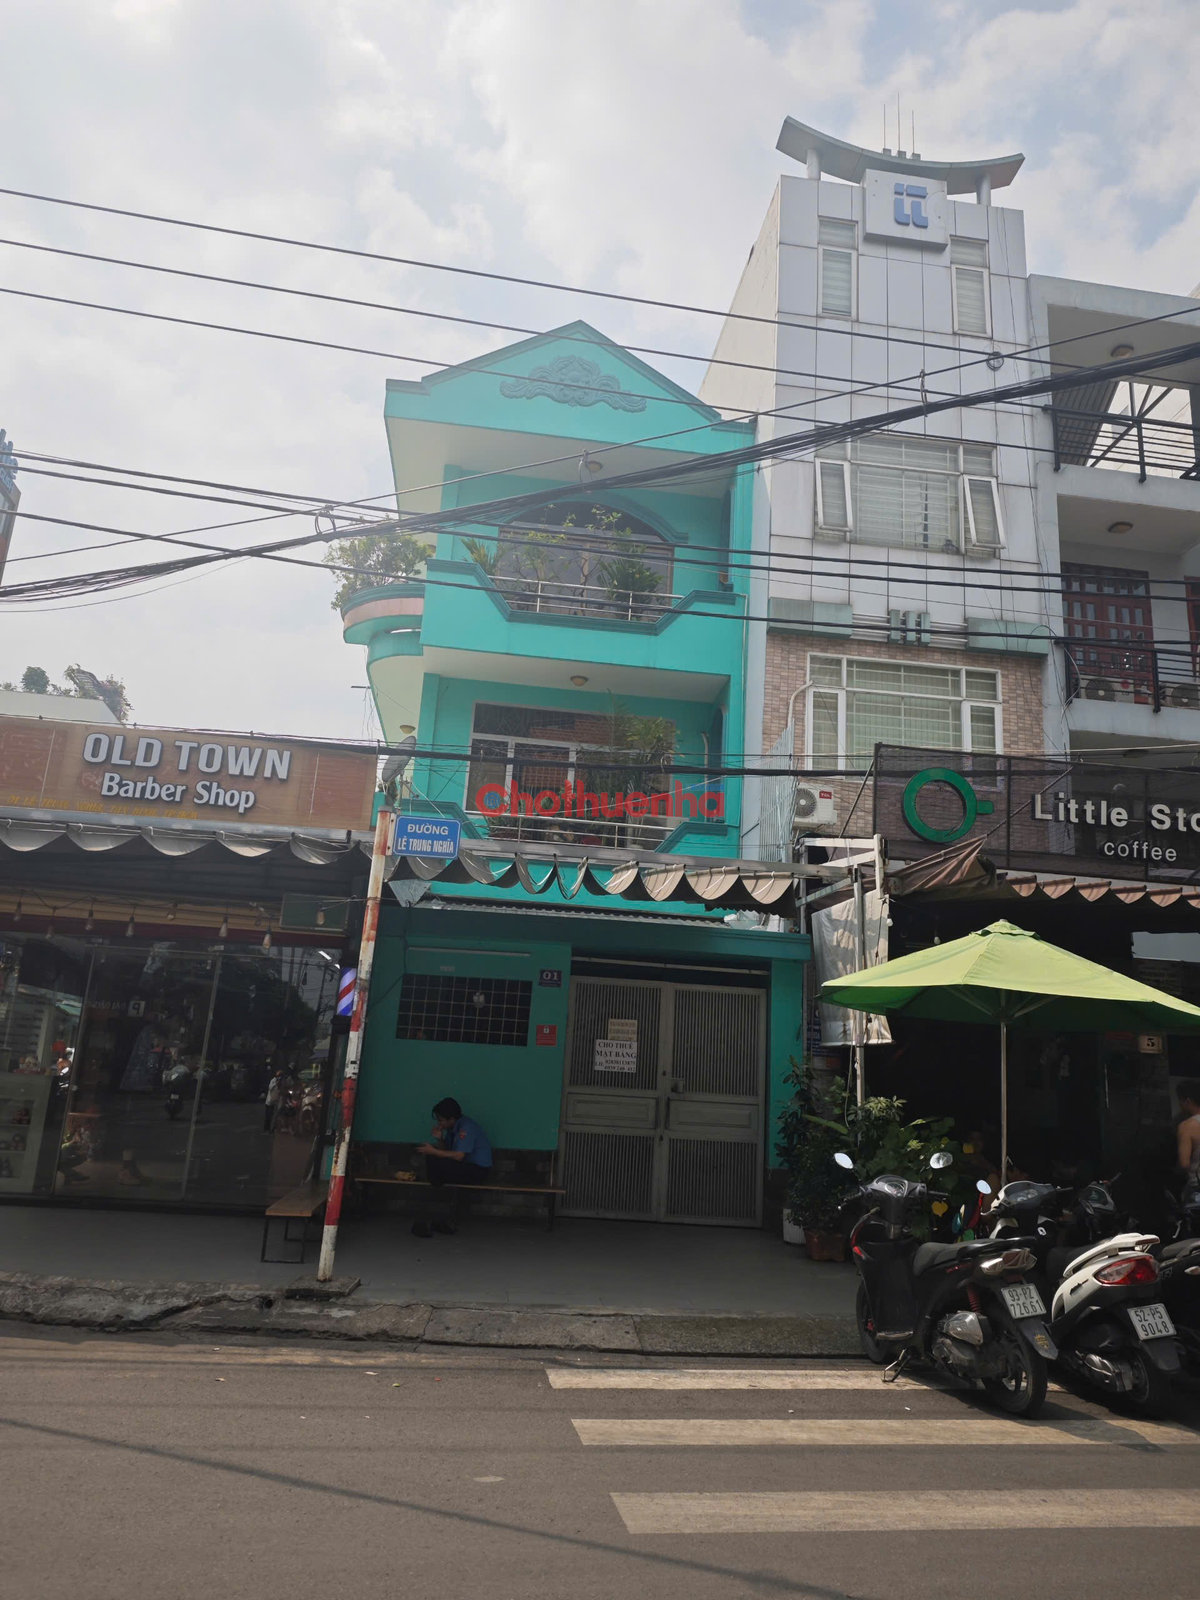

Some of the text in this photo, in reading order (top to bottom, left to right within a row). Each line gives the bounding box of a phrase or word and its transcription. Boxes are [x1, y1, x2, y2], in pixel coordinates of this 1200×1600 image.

[82, 732, 293, 780] OLD TOWN
[101, 772, 256, 814] Barber Shop
[1035, 791, 1129, 828] Little
[407, 822, 449, 836] ĐƯỜNG
[397, 835, 454, 854] LÊ TRUNG NGHĨA
[1104, 841, 1177, 862] coffee
[542, 971, 559, 981] 01
[598, 1041, 614, 1049] CHO
[1147, 1037, 1156, 1047] 5
[1010, 1299, 1043, 1317] 726.61
[1141, 1320, 1170, 1337] 9048
